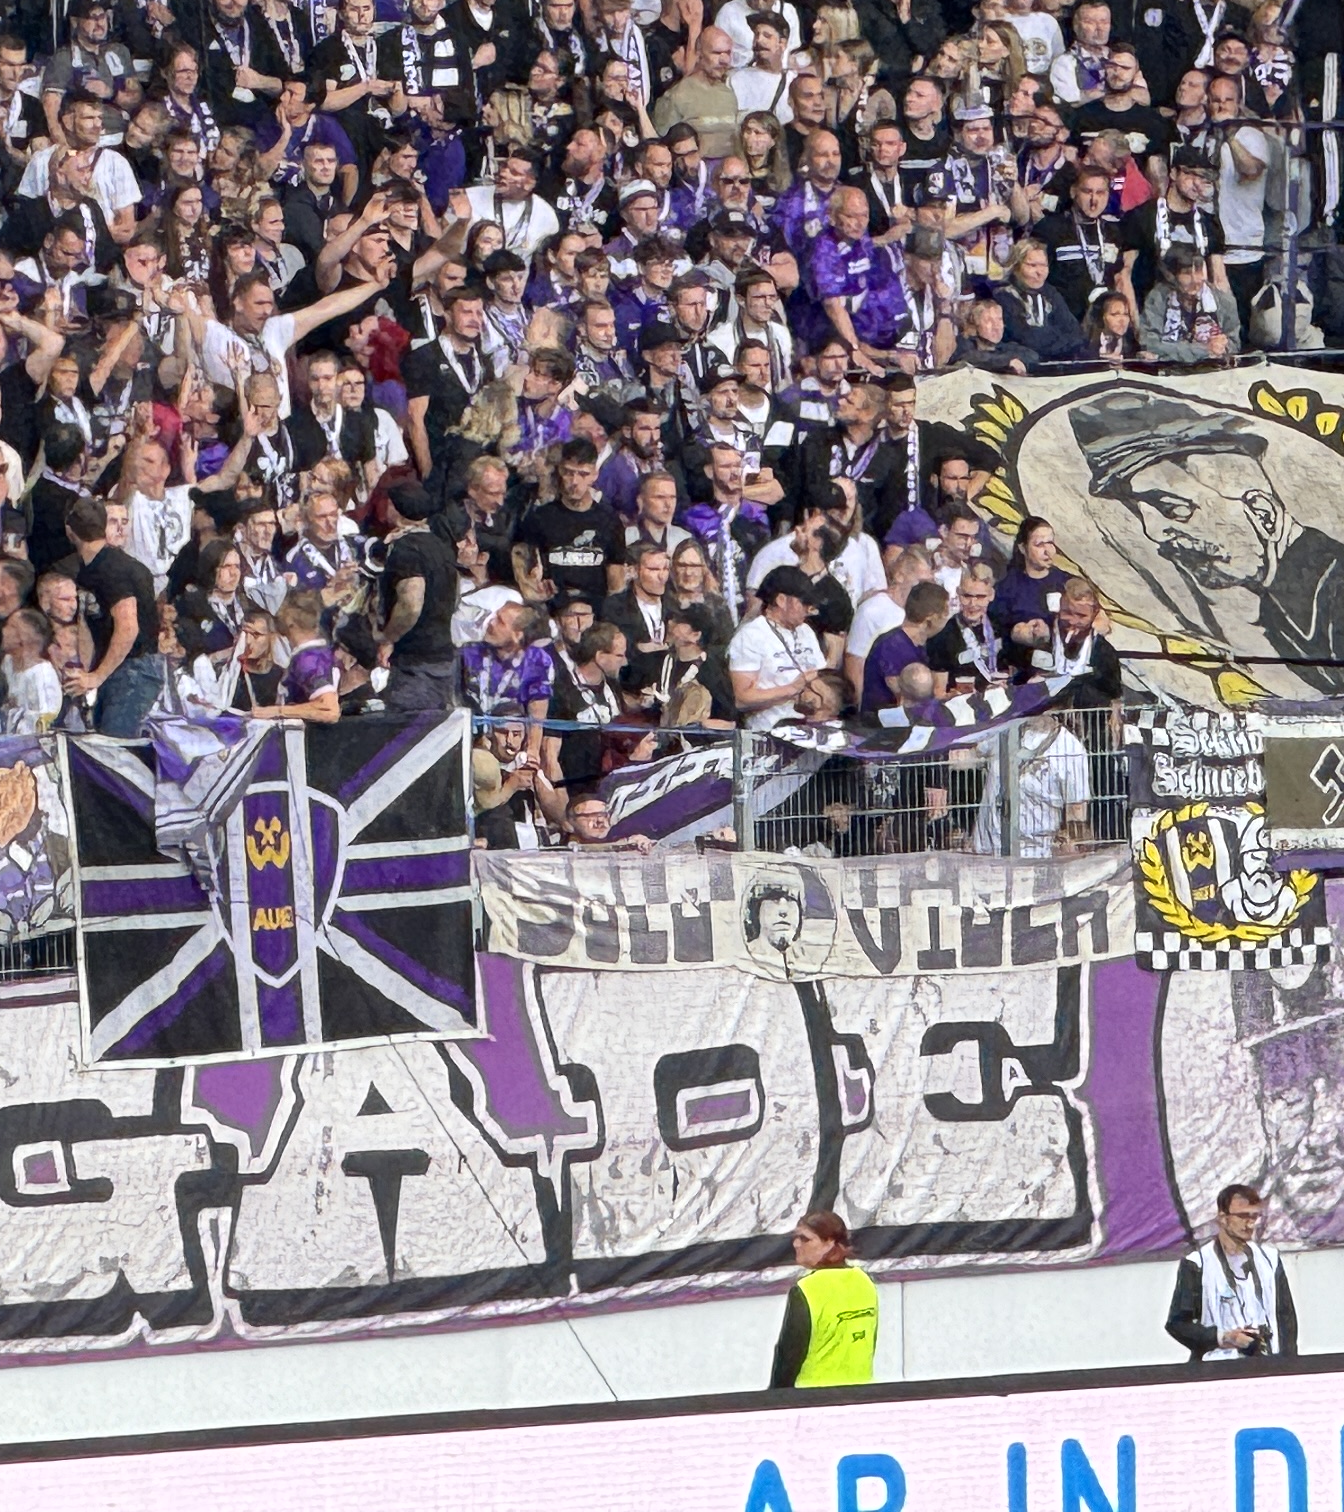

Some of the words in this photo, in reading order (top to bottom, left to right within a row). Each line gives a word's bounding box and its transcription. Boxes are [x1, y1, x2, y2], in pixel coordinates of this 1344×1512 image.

[1151, 752, 1267, 800] Schneeb
[252, 905, 294, 932] AUE
[1006, 1434, 1137, 1512] IN
[1234, 1425, 1344, 1512] D
